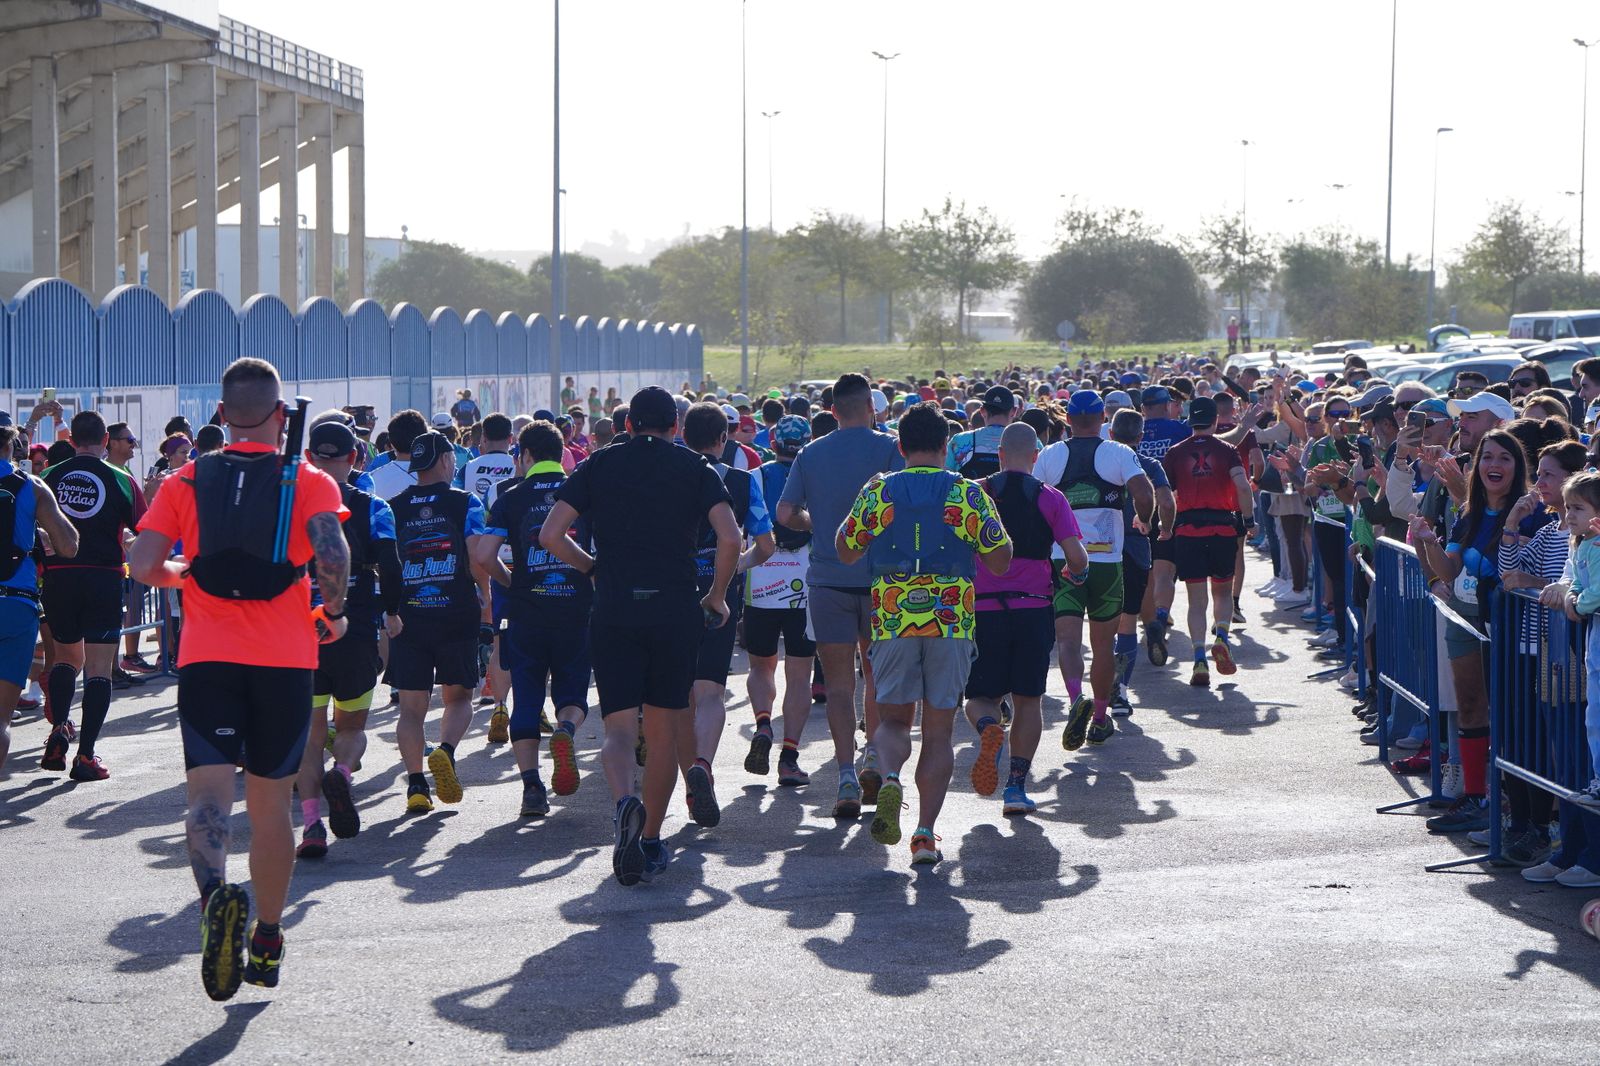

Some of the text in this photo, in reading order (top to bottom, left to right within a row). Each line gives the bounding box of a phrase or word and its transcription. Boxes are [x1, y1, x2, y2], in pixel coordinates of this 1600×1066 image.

[476, 466, 513, 475] BYON
[57, 482, 96, 494] Donando
[57, 490, 96, 506] Vidas
[415, 516, 446, 527] ROSALEDA
